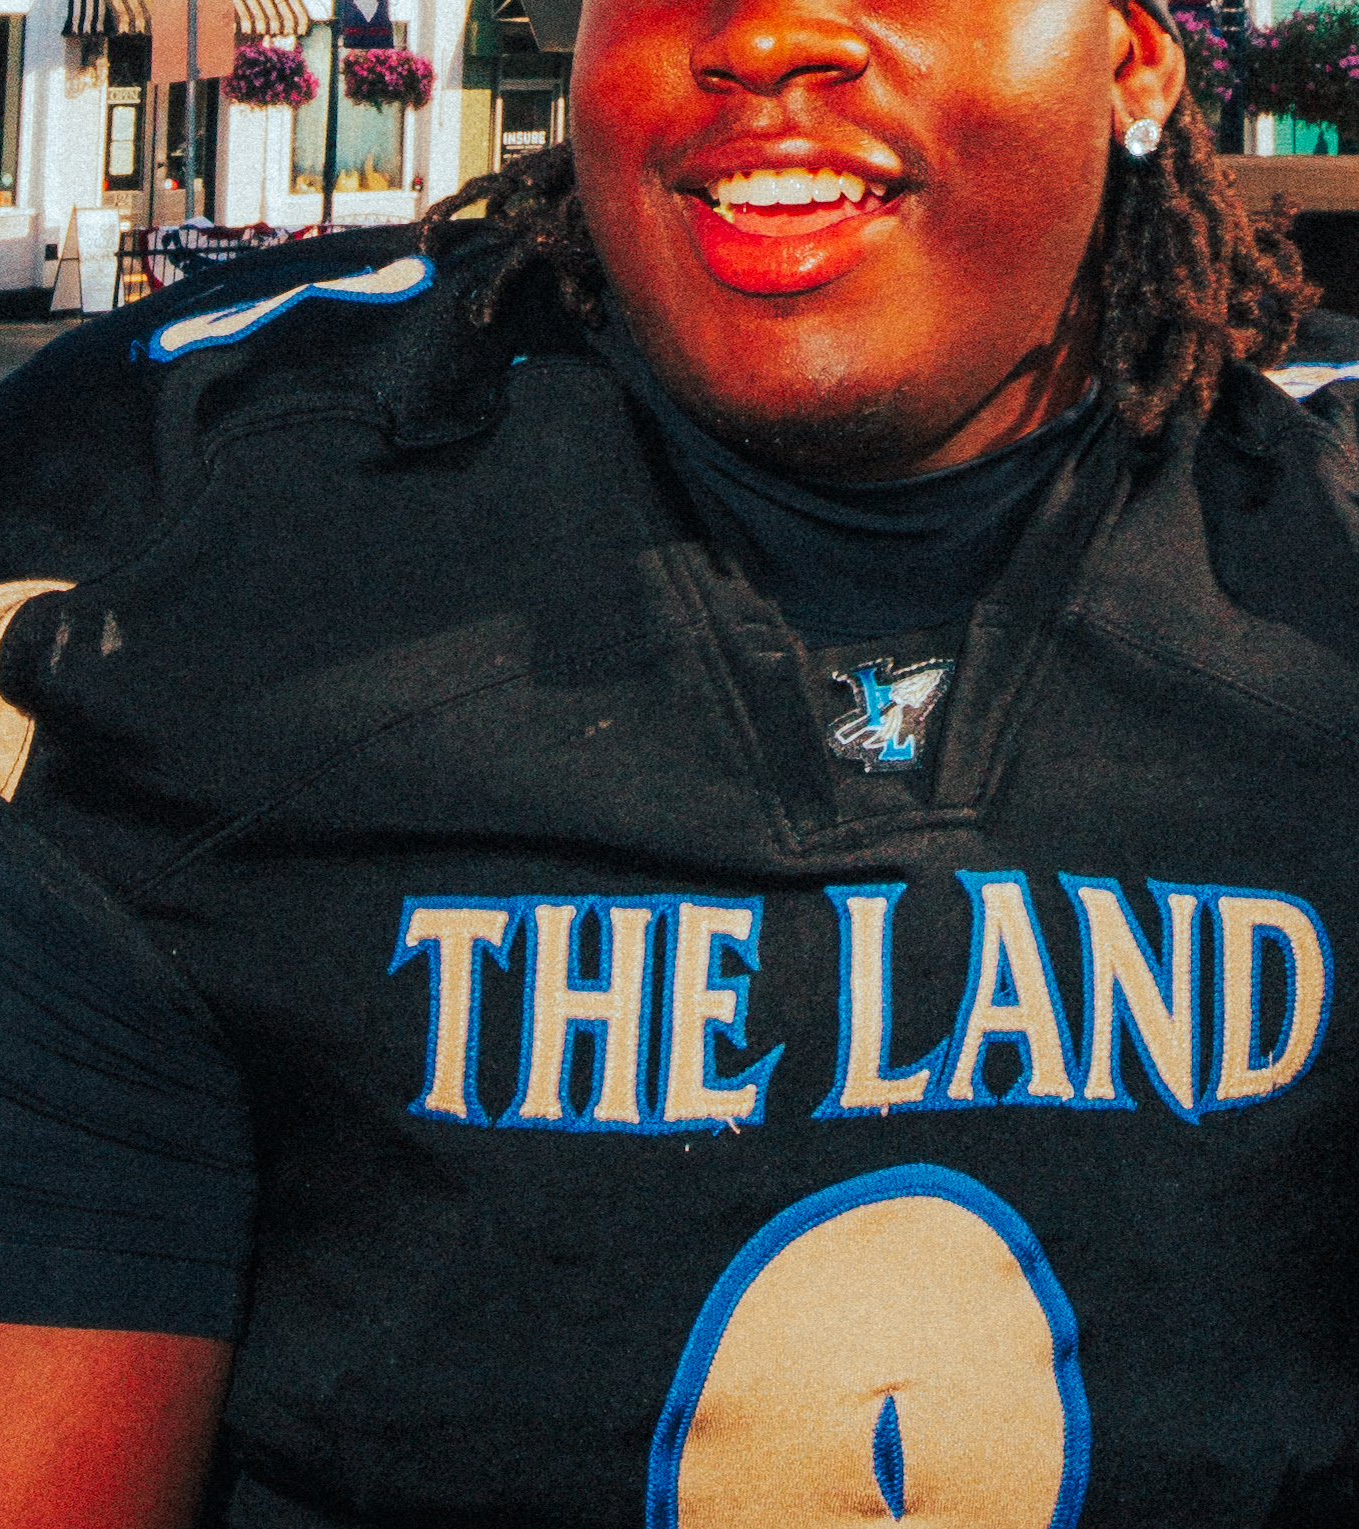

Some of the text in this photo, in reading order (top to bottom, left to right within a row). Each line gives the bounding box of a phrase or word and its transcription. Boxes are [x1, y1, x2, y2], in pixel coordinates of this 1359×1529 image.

[503, 130, 547, 145] INSURE
[387, 870, 1334, 1134] THE LAND
